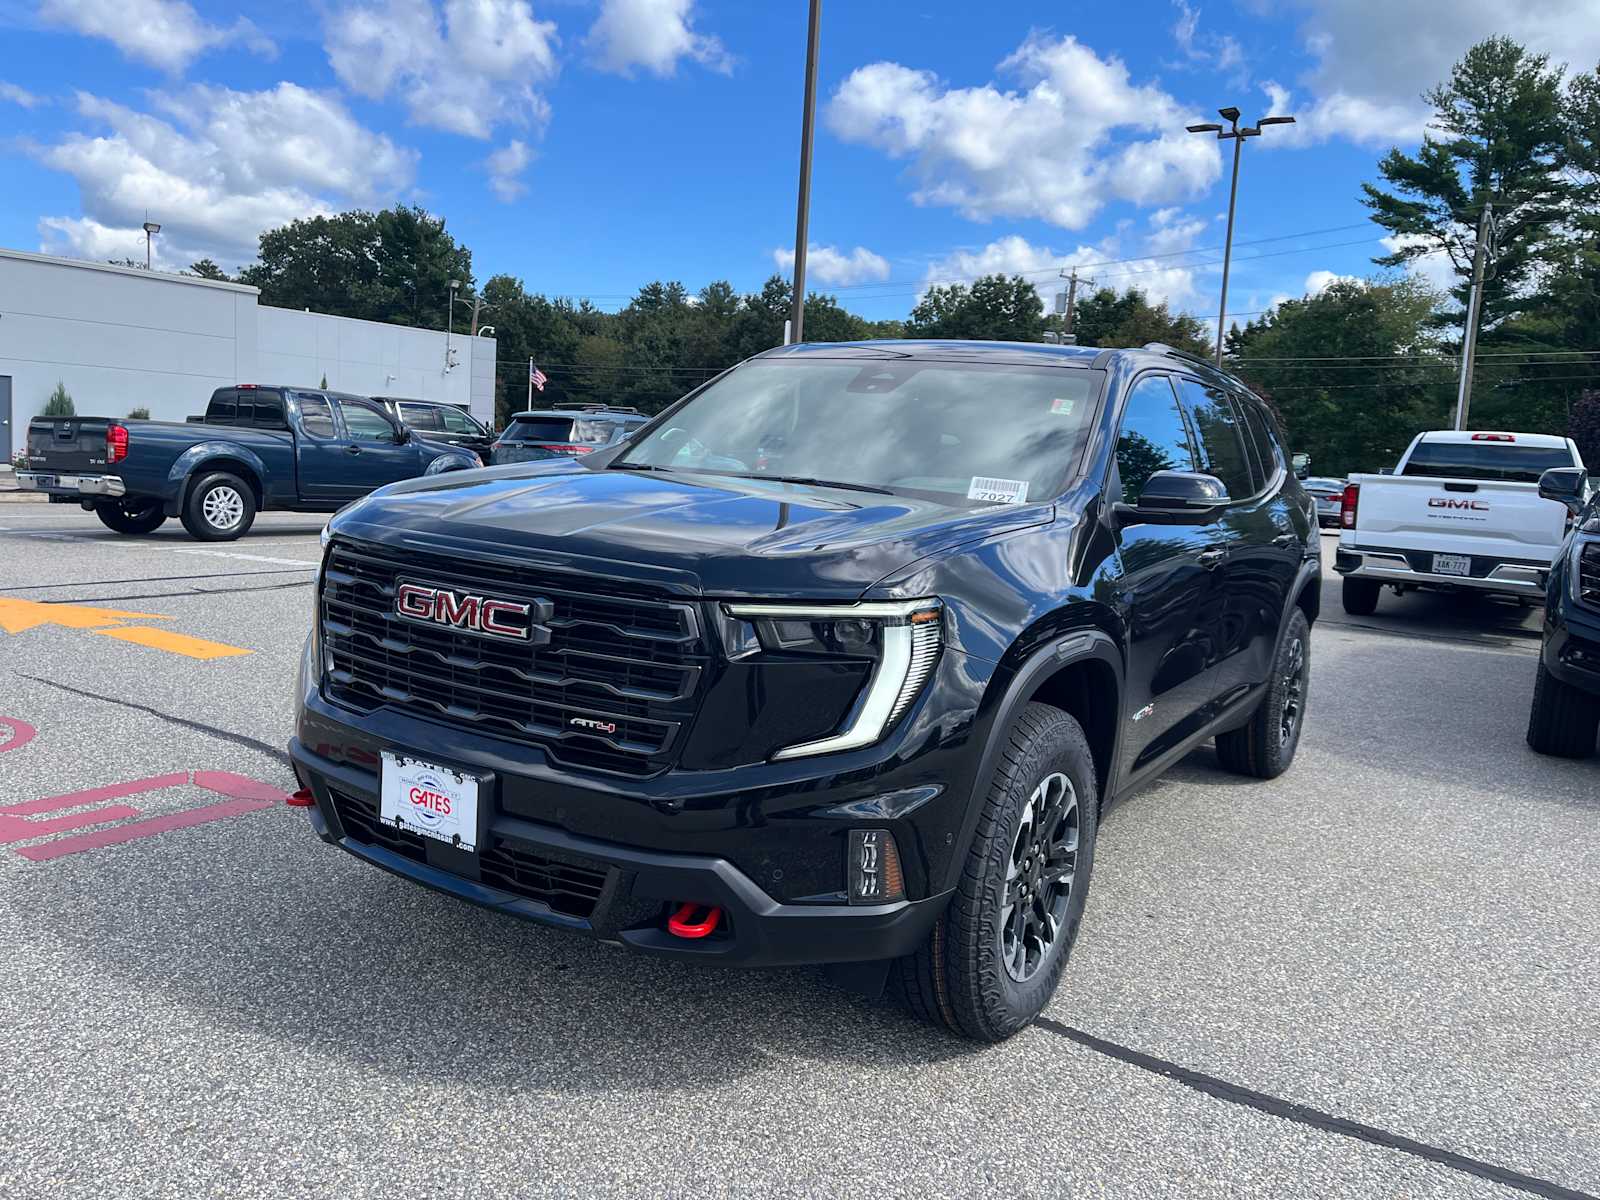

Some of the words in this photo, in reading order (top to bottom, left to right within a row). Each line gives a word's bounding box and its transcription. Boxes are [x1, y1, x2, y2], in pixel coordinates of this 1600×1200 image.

[980, 492, 1015, 502] 7027
[1428, 498, 1489, 511] GMC
[398, 584, 531, 638] GMC
[570, 717, 616, 733] AT4
[410, 787, 451, 815] GATES
